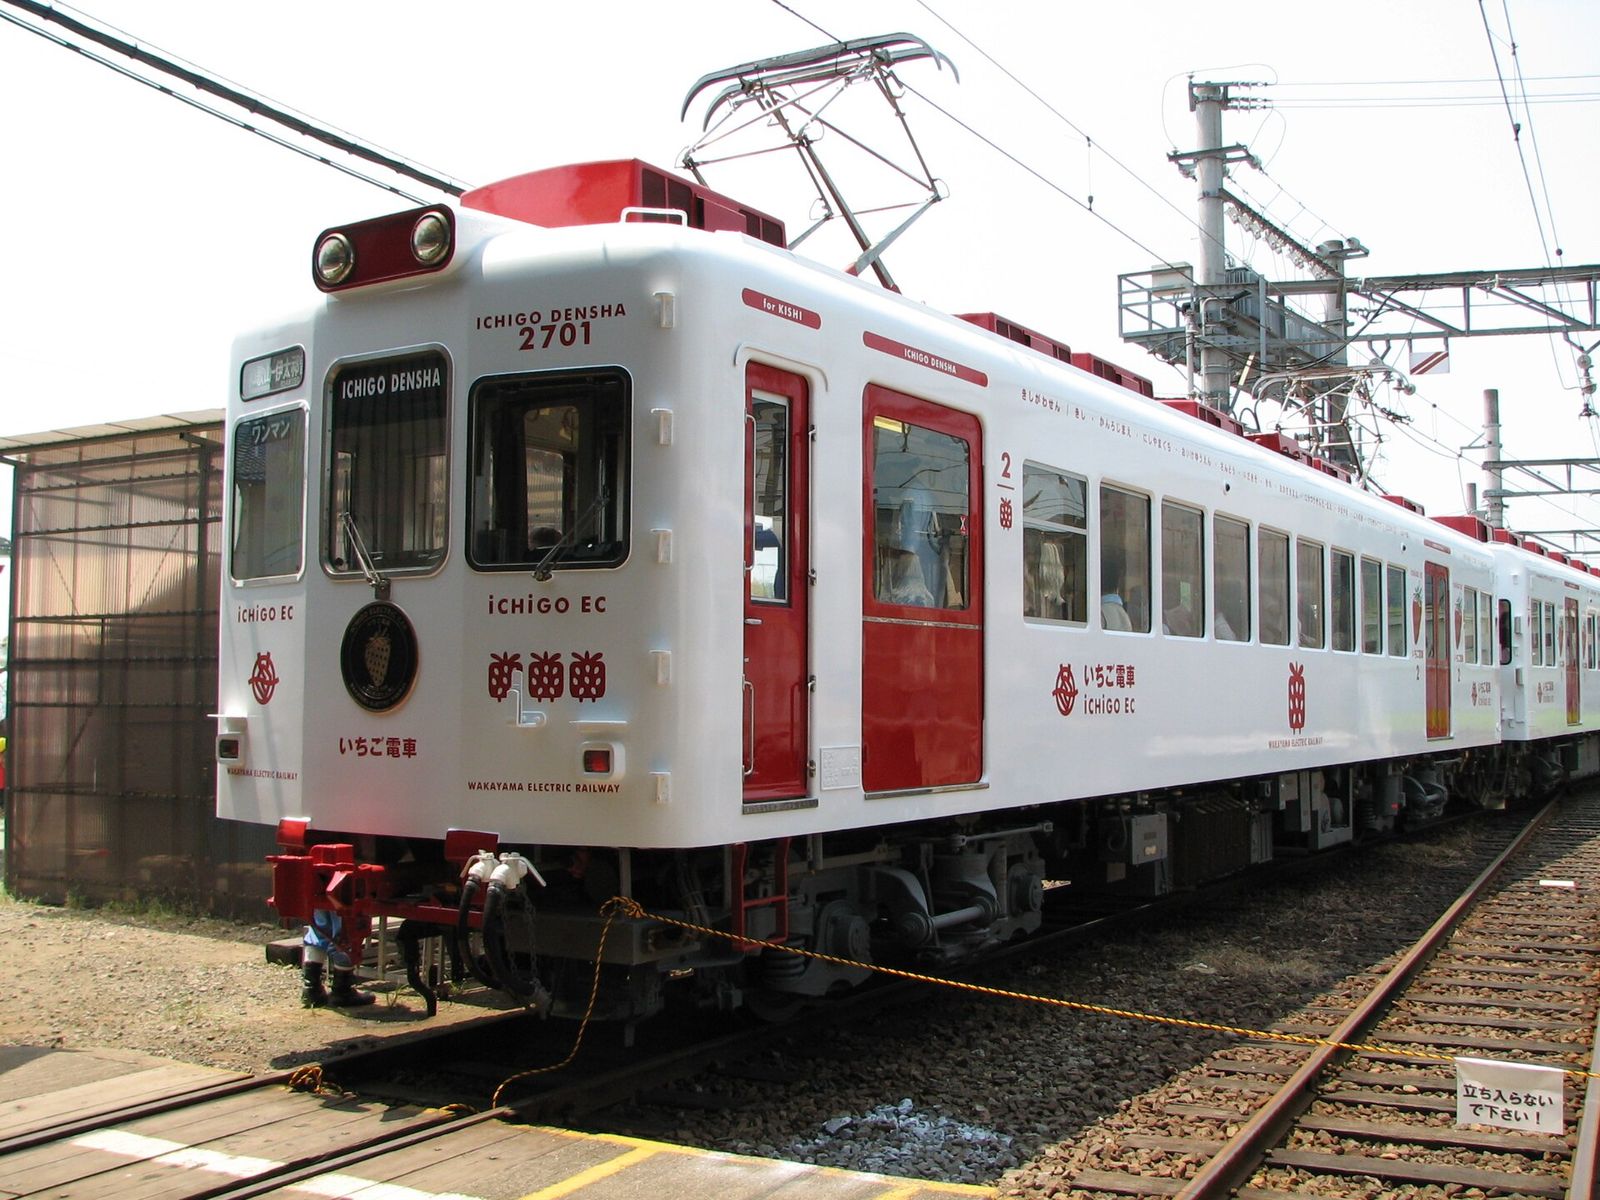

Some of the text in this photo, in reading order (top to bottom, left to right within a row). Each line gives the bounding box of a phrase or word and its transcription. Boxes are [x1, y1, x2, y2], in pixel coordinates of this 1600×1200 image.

[476, 303, 626, 330] ICHIGO DENSHA
[763, 298, 802, 320] for KISHI
[519, 321, 591, 351] 2701
[904, 348, 957, 374] ICHIGO DENSHA
[342, 367, 441, 399] ICHIGO DENSHA
[252, 420, 291, 444] ワンマン
[1001, 452, 1011, 479] 2
[281, 605, 294, 620] EC
[581, 596, 606, 613] EC
[1084, 663, 1135, 688] いちご電車
[1124, 697, 1135, 714] EC
[339, 737, 417, 758] いちご電車
[468, 781, 620, 793] WAKAYAMA ELECTRIC RAILWAY
[1462, 1084, 1553, 1107] 立ち入らない
